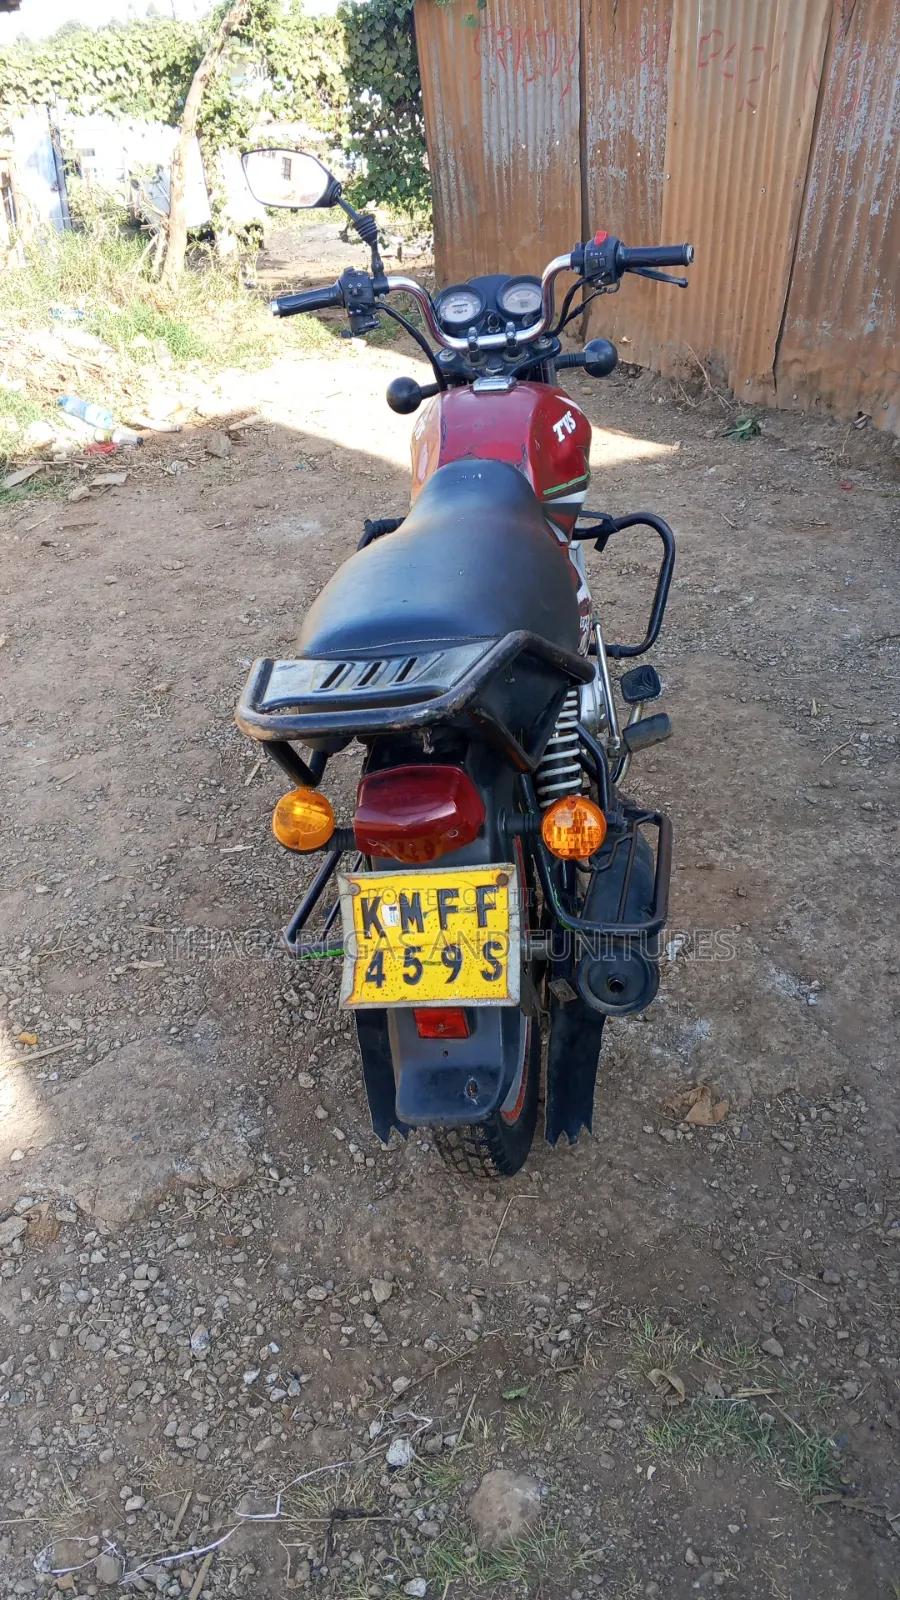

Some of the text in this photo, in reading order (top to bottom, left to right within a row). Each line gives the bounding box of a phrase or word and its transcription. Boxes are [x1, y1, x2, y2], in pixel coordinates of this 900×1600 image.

[552, 410, 577, 443] TVS
[361, 884, 500, 940] KMFF
[365, 941, 504, 989] 459S
